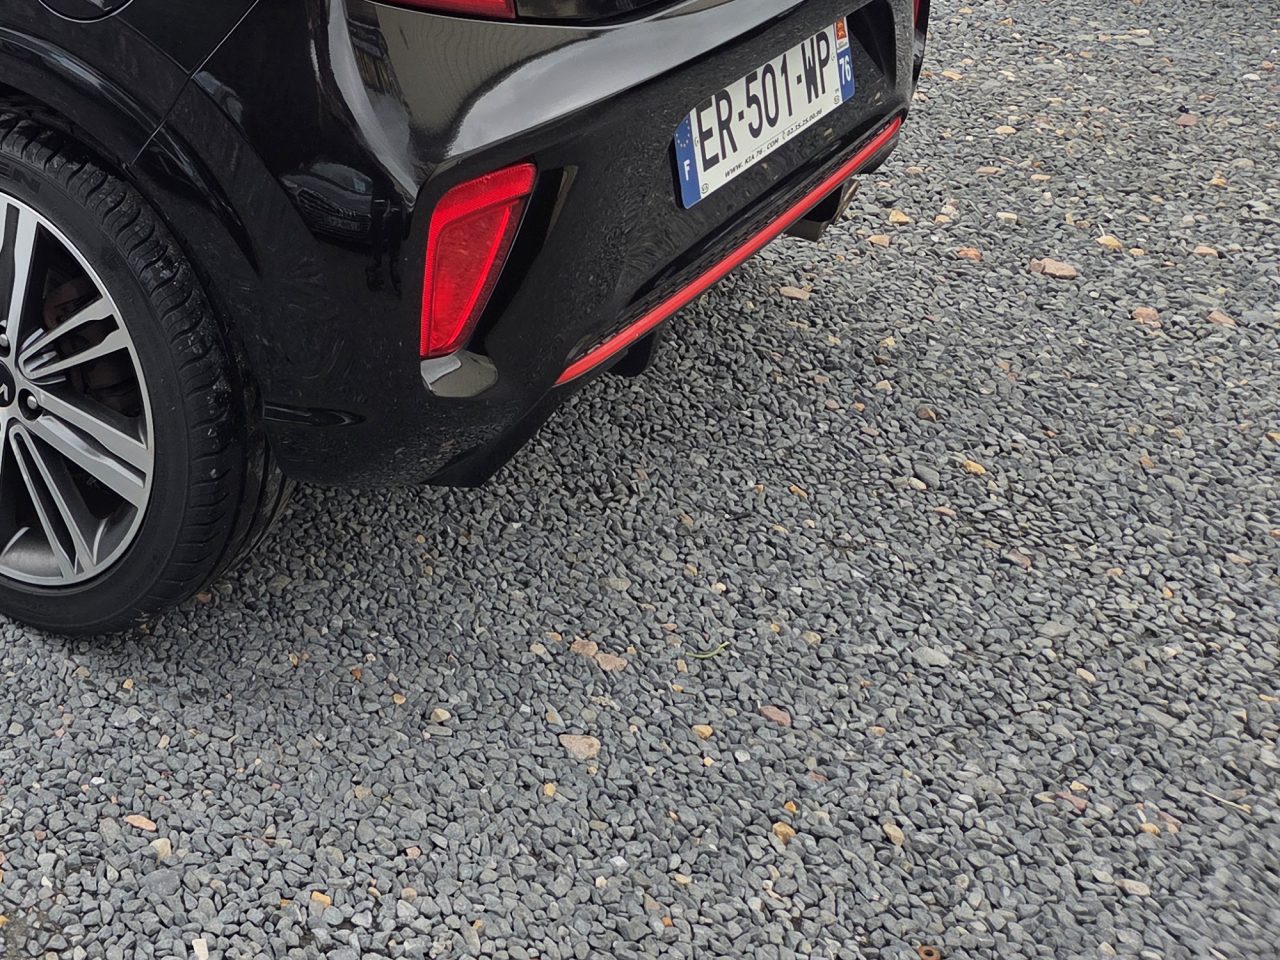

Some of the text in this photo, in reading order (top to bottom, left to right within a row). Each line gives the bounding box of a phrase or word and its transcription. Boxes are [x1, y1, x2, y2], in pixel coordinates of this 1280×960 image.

[838, 55, 852, 86] 76
[695, 31, 830, 172] ER-501-WP
[683, 159, 691, 181] F
